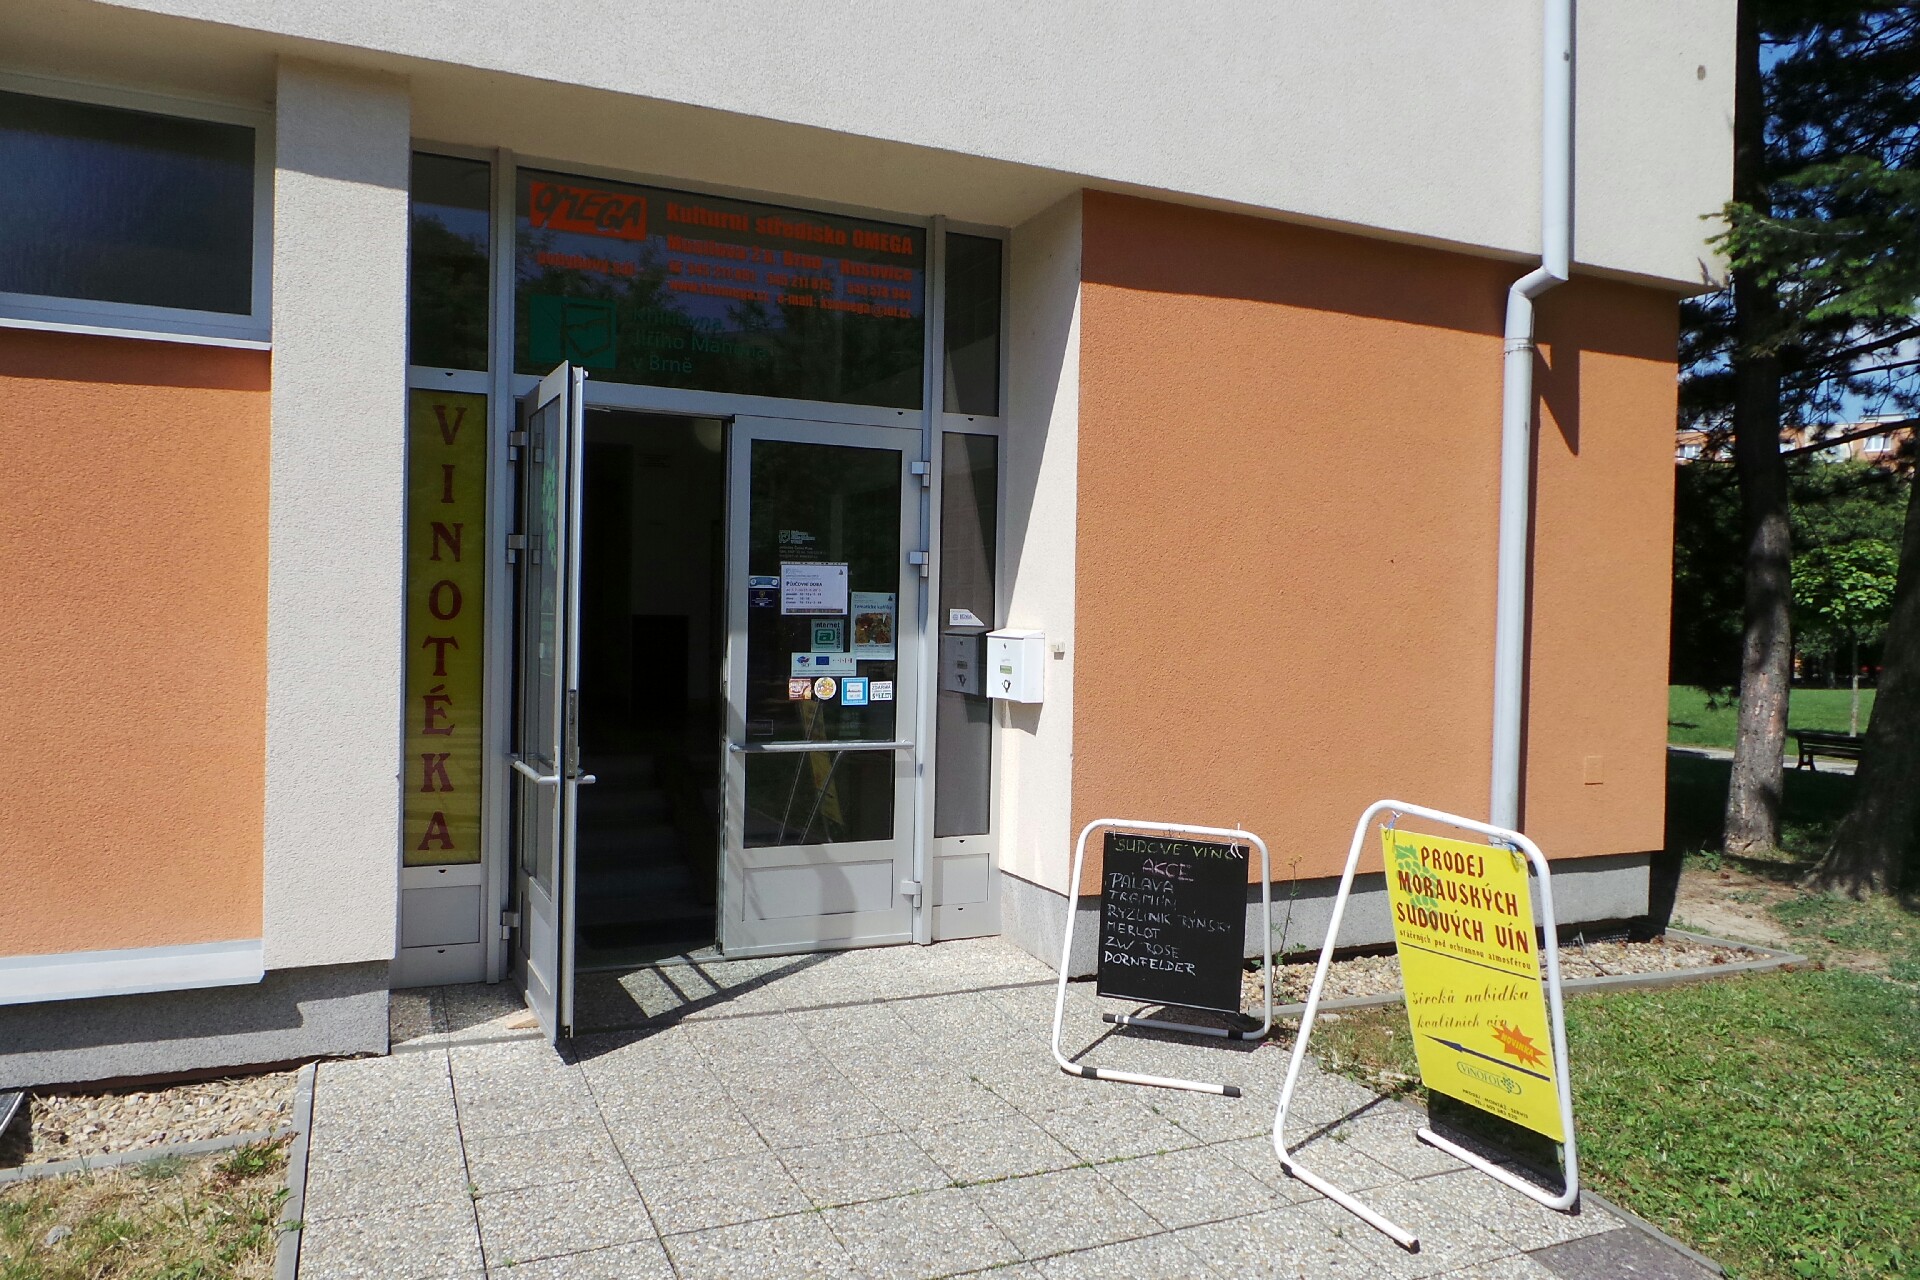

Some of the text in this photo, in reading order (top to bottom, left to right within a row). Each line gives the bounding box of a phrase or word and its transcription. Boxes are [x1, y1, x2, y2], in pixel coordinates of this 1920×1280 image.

[755, 214, 846, 246] středisko
[852, 228, 913, 256] OMEGA
[649, 353, 693, 374] Brně
[417, 404, 468, 852] VINOTÉKA
[1142, 858, 1192, 878] AKCE
[1420, 845, 1485, 878] PRODEJ
[1107, 921, 1161, 939] MERLOT
[1396, 901, 1530, 954] SUDOVÝCH VÍN
[1105, 936, 1135, 950] ZW
[1434, 938, 1447, 949] pod
[1449, 943, 1485, 959] ochrannou
[1104, 950, 1197, 976] DORNFELDER
[1500, 1032, 1535, 1058] NOVINKA
